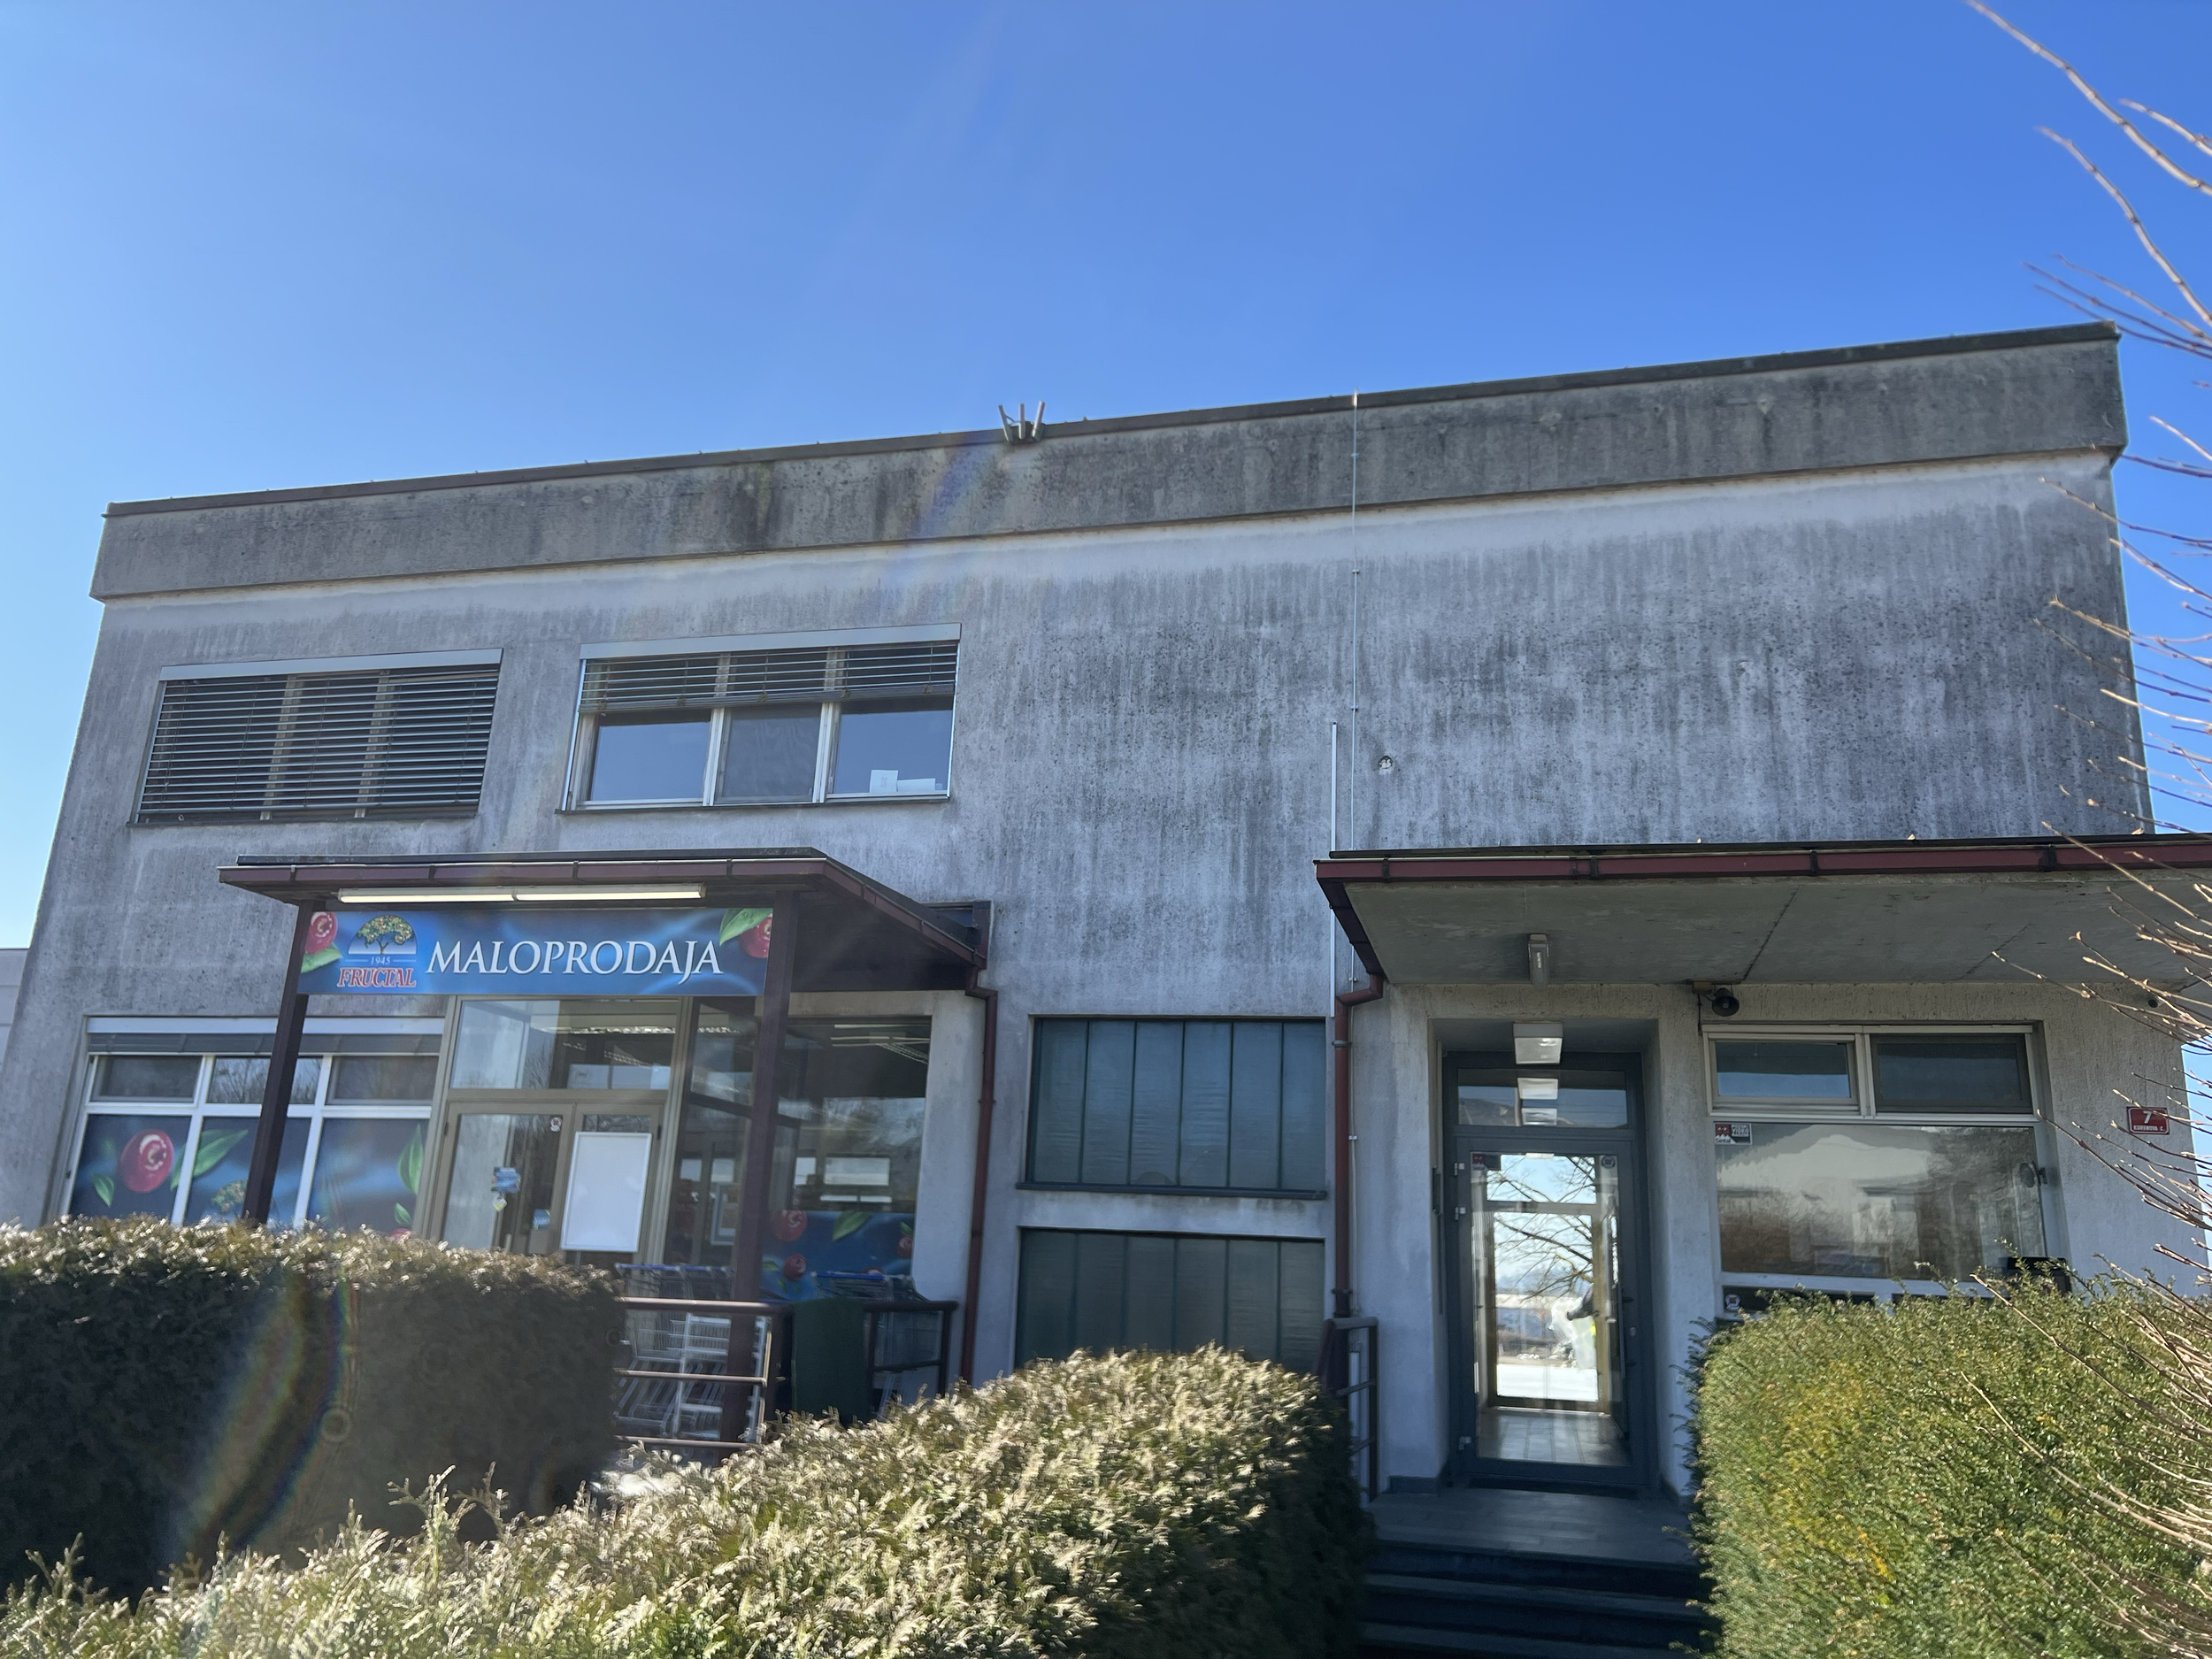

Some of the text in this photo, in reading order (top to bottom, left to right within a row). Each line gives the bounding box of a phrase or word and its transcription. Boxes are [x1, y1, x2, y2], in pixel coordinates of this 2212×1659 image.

[371, 956, 391, 965] 1945
[426, 941, 724, 985] MALOPRODAJA
[336, 967, 417, 987] FRUCTAL
[2143, 1110, 2152, 1124] 7
